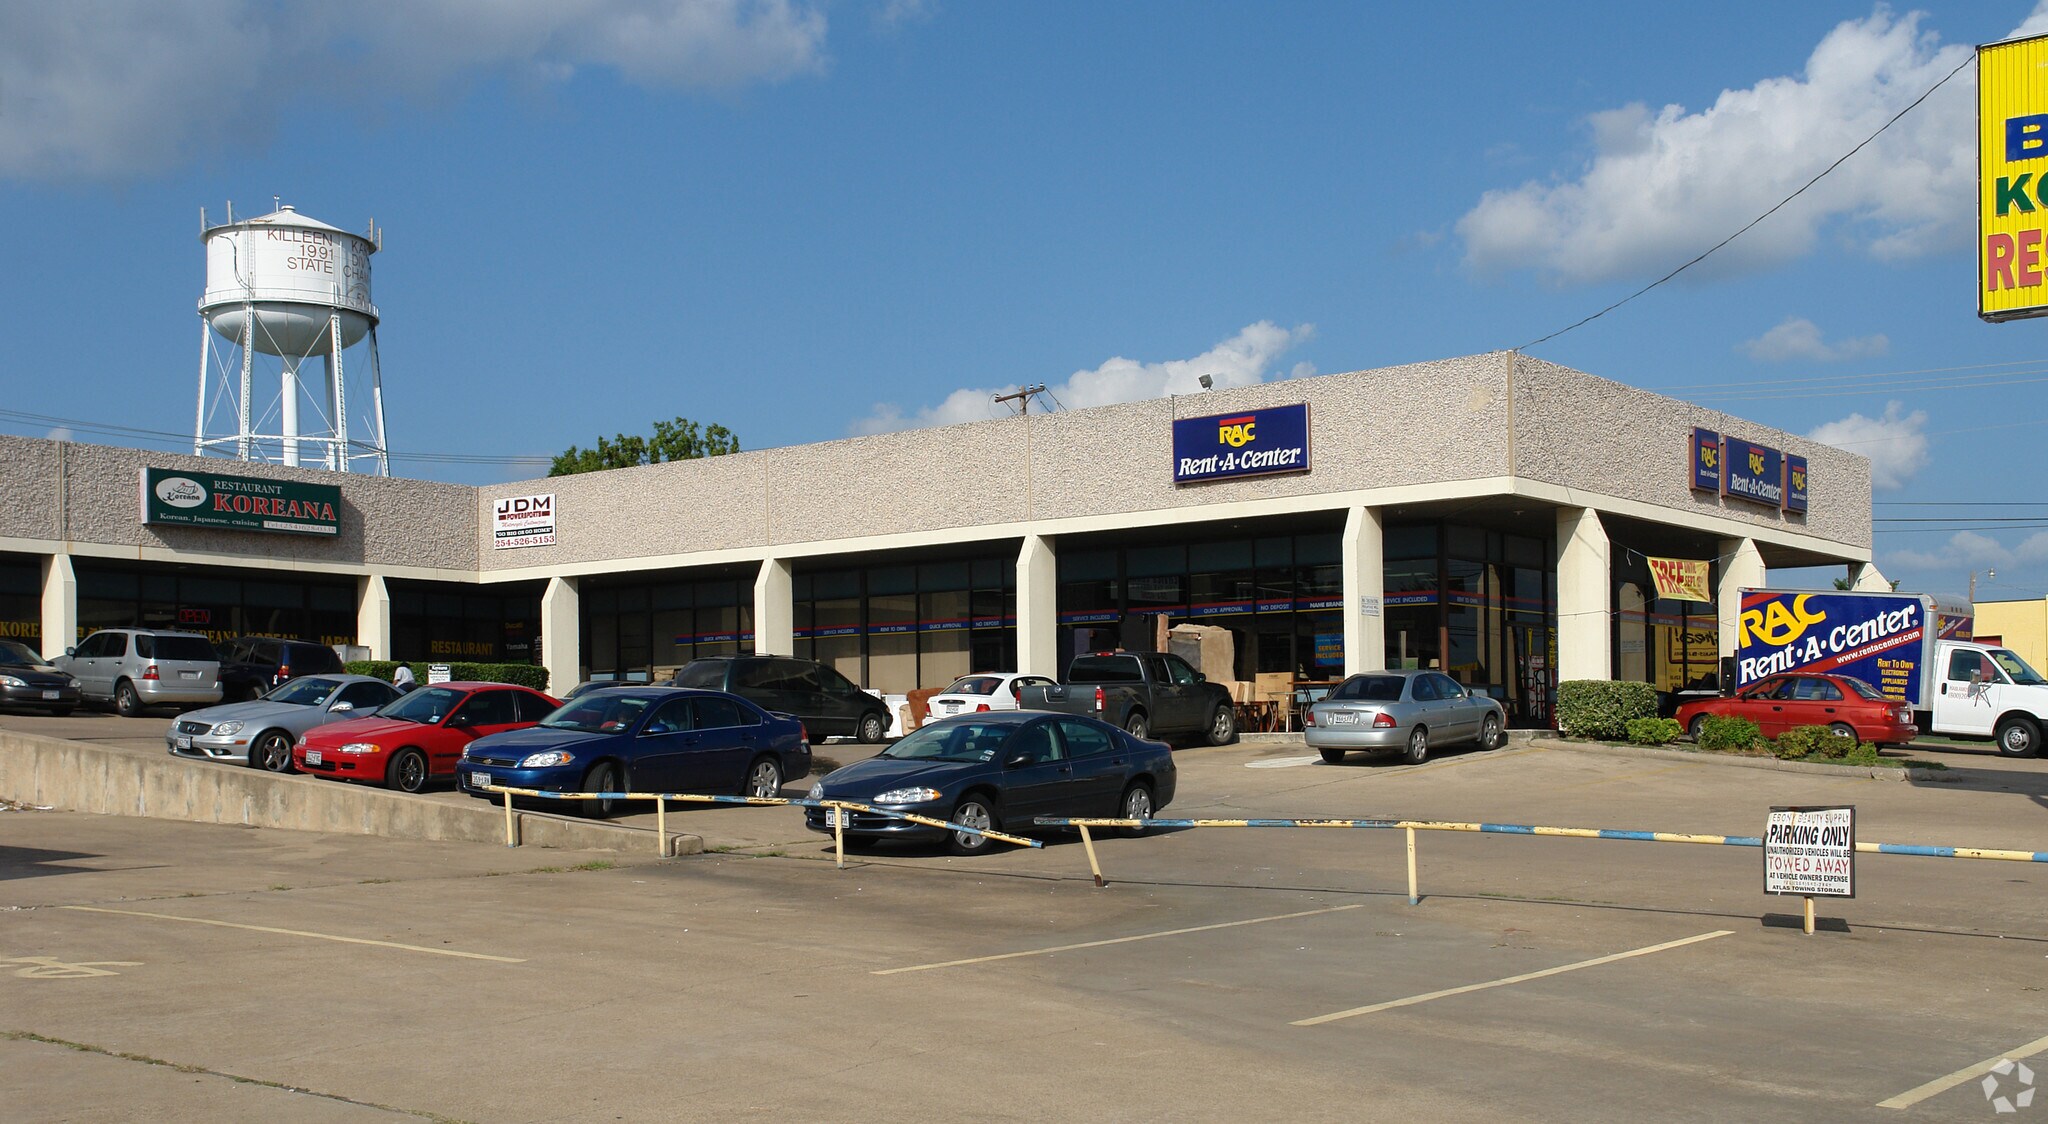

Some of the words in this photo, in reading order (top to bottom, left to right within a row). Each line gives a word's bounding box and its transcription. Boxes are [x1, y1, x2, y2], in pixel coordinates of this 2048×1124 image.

[267, 228, 333, 246] KILLEEN
[300, 244, 334, 260] 1991
[287, 257, 333, 274] STATE
[1220, 423, 1256, 448] RAC
[1701, 446, 1717, 468] RAC
[1749, 453, 1765, 475] RAC
[213, 480, 283, 495] RESTAURANT
[1792, 471, 1805, 491] RAC
[162, 491, 201, 502] Koreana
[497, 496, 551, 513] JDM
[213, 492, 337, 521] KOREANA
[231, 519, 260, 527] cuisine
[507, 511, 542, 521] POWERSPORTS
[495, 535, 555, 547] 254-526-5153
[1652, 560, 1687, 594] FREE
[179, 609, 210, 623] OPEN
[1739, 594, 1827, 649] RAC
[0, 621, 43, 638] KORE
[431, 640, 494, 656] RESTAURANT
[1836, 631, 1920, 664] www.rentacenter.com
[1881, 669, 1909, 677] ELECTRONICS
[1773, 813, 1795, 822] EBONY
[1798, 814, 1823, 824] BEAUTY
[1825, 813, 1849, 824] SUPPLY
[1769, 824, 1819, 845] PARKING
[1822, 826, 1849, 847] ONLY
[1767, 846, 1804, 856] UNAUTHORIZED
[1804, 848, 1829, 857] VEHICLES
[1830, 849, 1842, 857] WILL
[1843, 850, 1850, 858] BE
[1768, 856, 1810, 872] TOWED
[1815, 859, 1849, 874] AWAY
[1799, 873, 1822, 882] OWNERS
[1823, 874, 1849, 883] EXPENSE
[1817, 886, 1845, 894] STORAGE
